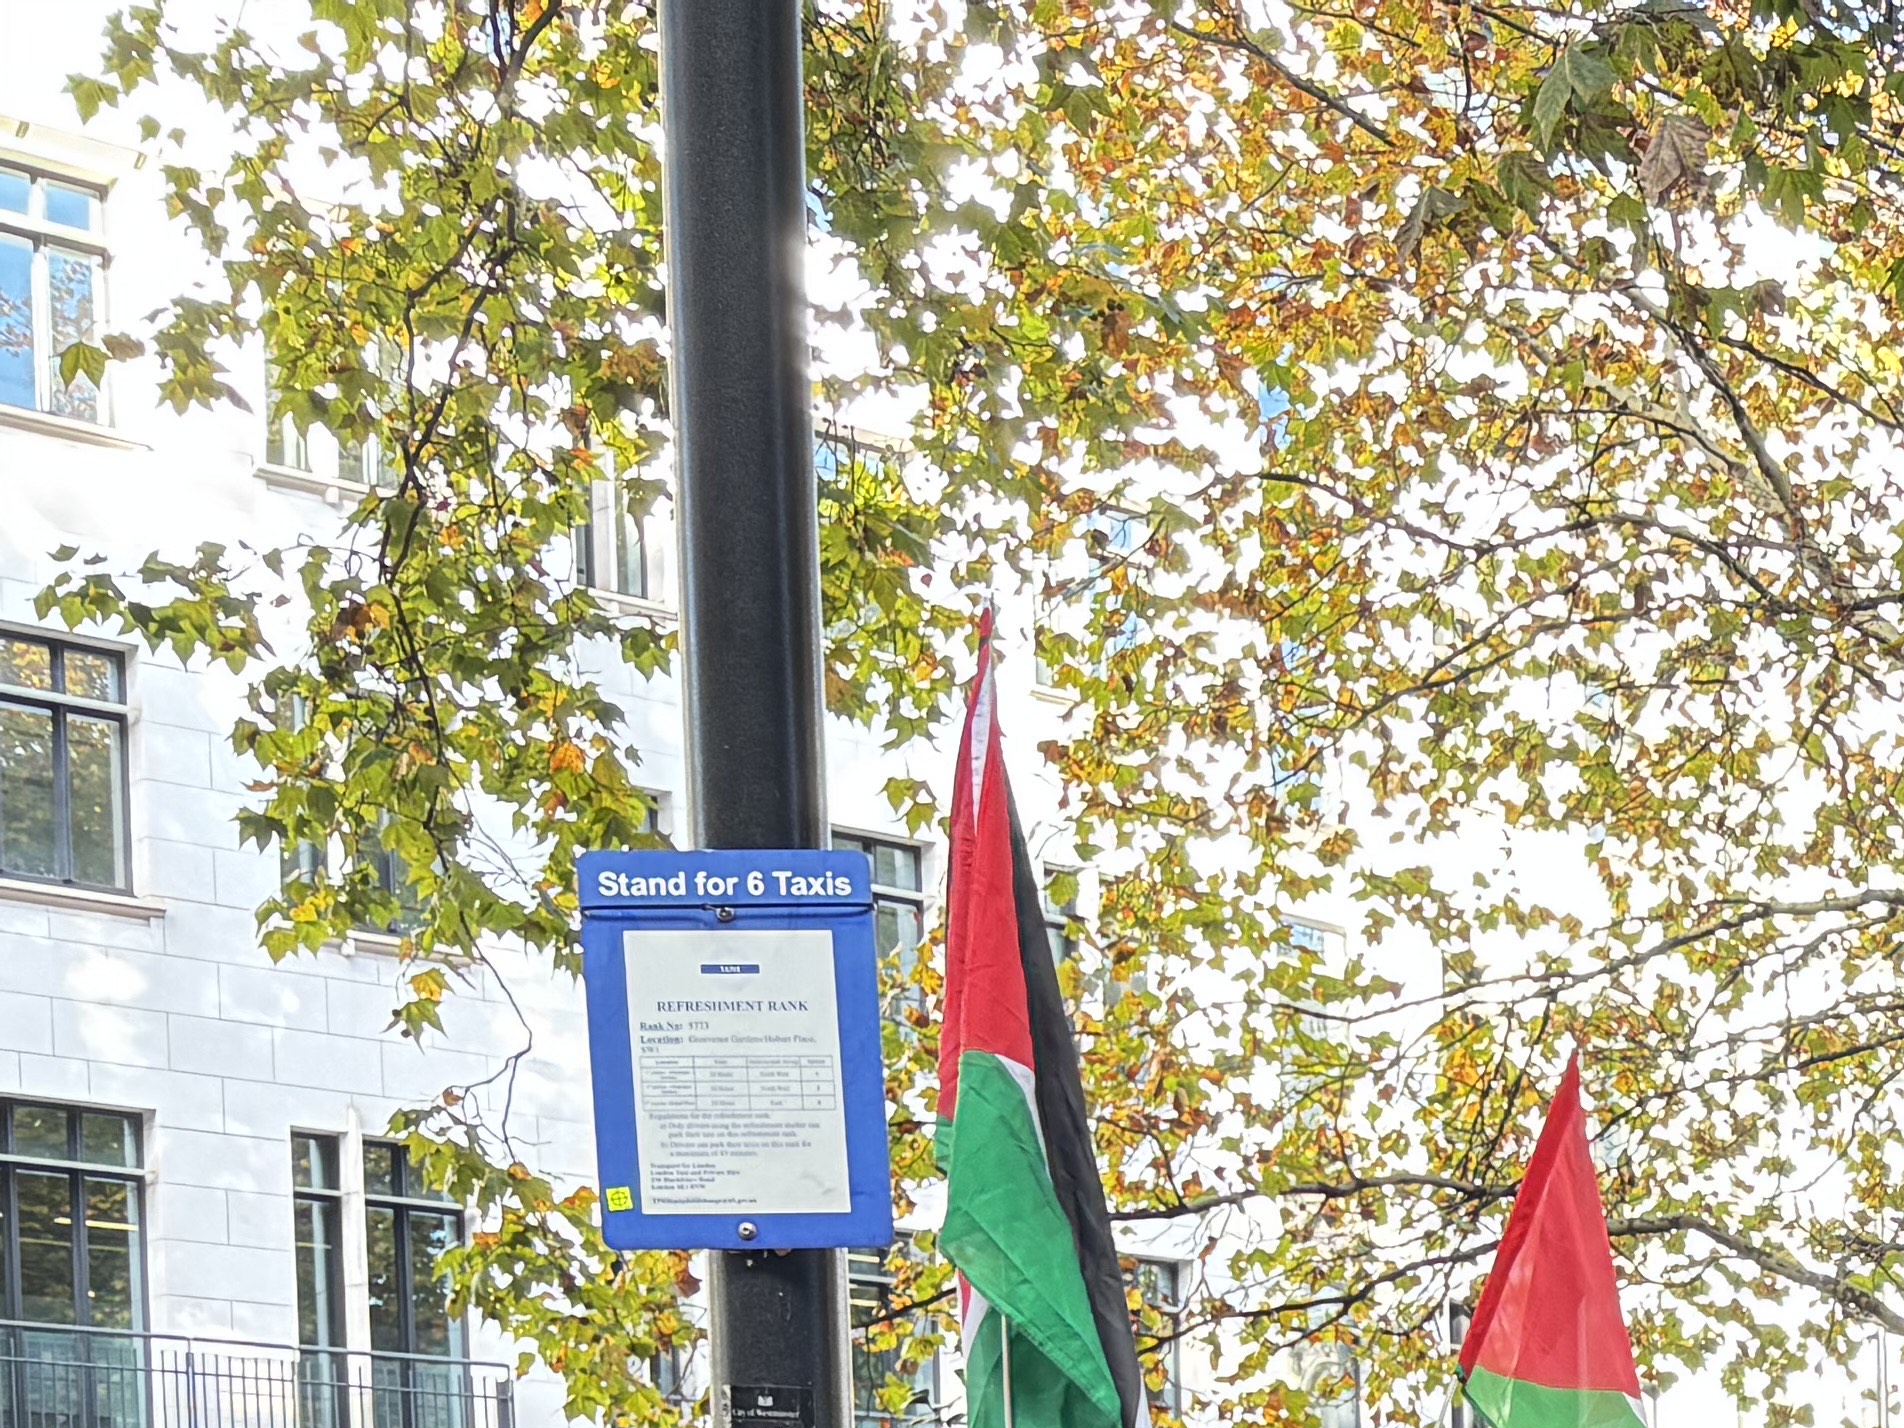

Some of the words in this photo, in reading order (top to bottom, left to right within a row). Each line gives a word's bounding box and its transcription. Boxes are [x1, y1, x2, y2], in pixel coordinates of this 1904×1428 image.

[598, 870, 687, 897] Stand
[694, 870, 739, 897] for
[746, 870, 765, 897] 6
[771, 870, 852, 897] Taxis
[657, 1000, 764, 1012] REFRESHMENT
[768, 1001, 808, 1012] RANK
[640, 1022, 665, 1031] Rank
